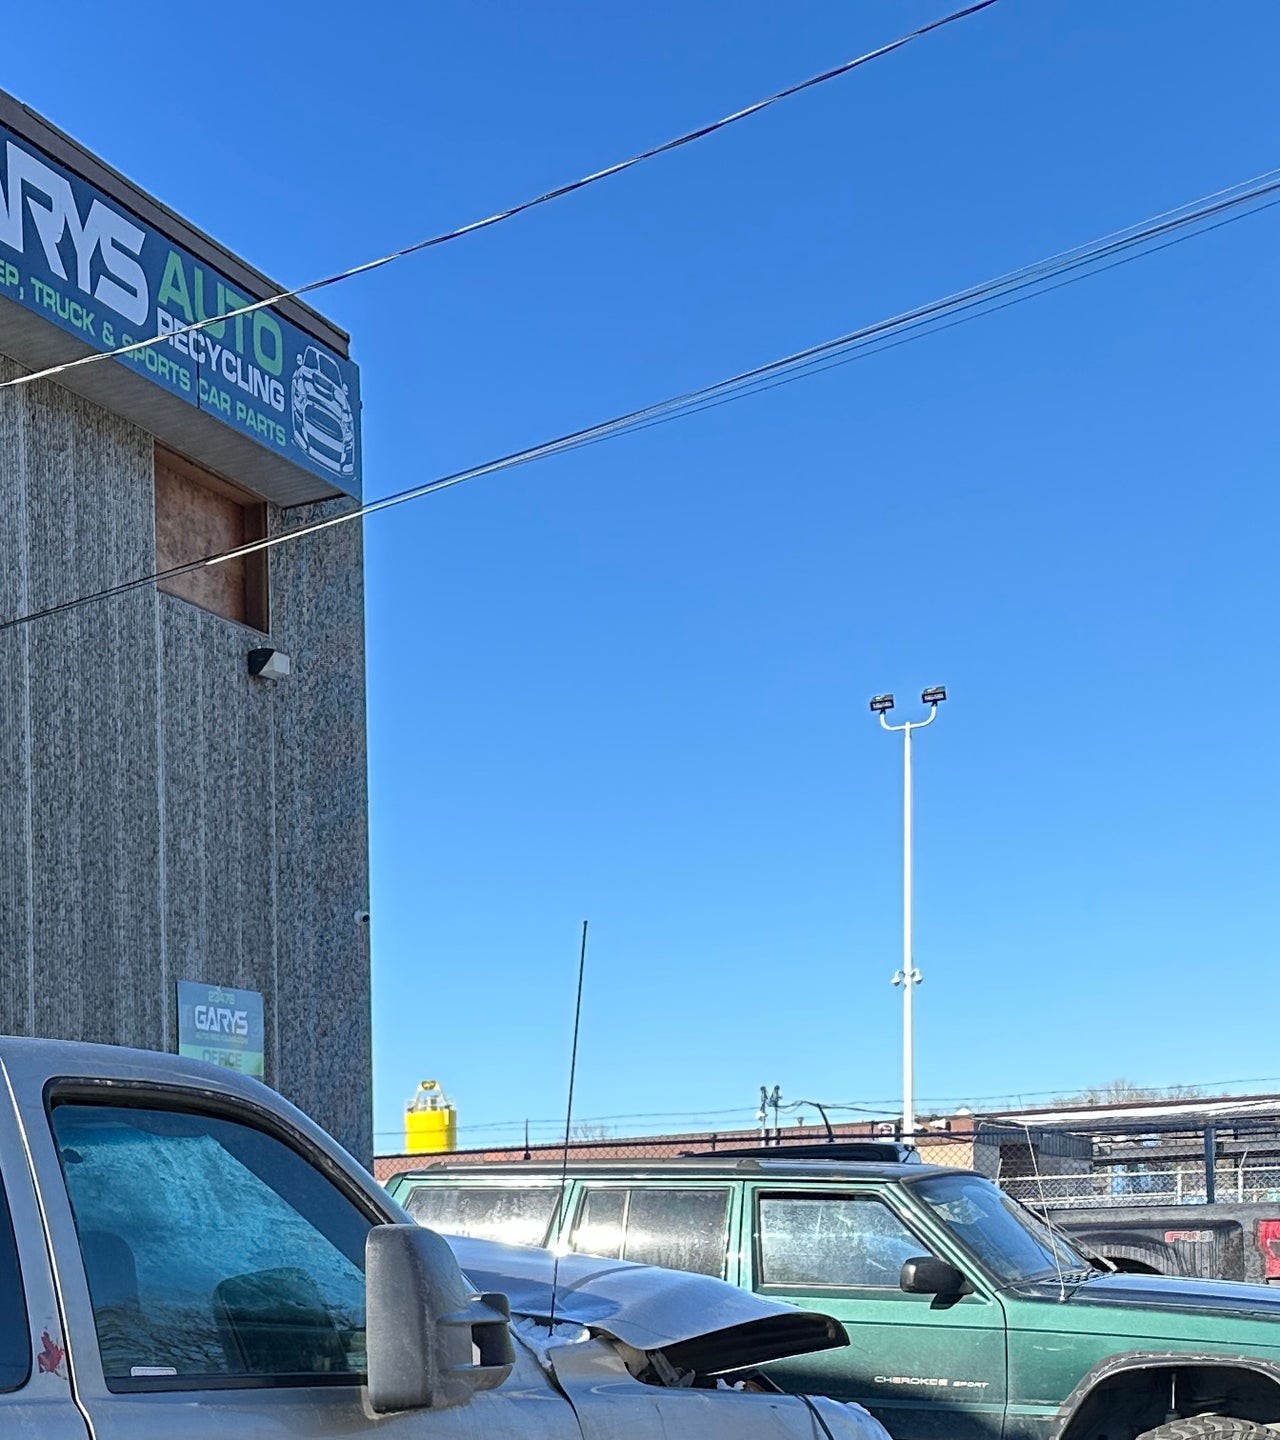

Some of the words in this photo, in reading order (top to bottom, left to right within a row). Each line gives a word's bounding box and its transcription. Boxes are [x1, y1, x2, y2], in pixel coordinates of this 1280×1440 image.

[157, 250, 283, 376] AUTO
[31, 277, 95, 336] TRUCK
[102, 321, 115, 347] &
[122, 333, 191, 392] SPORTS
[198, 379, 231, 415] CAR
[236, 401, 287, 446] PARTS
[157, 307, 285, 412] RECYCLING
[195, 1005, 248, 1035] GARYS
[203, 1049, 242, 1067] OFFICE
[874, 1376, 948, 1386] CHEROKEE
[952, 1380, 989, 1388] SPORT
